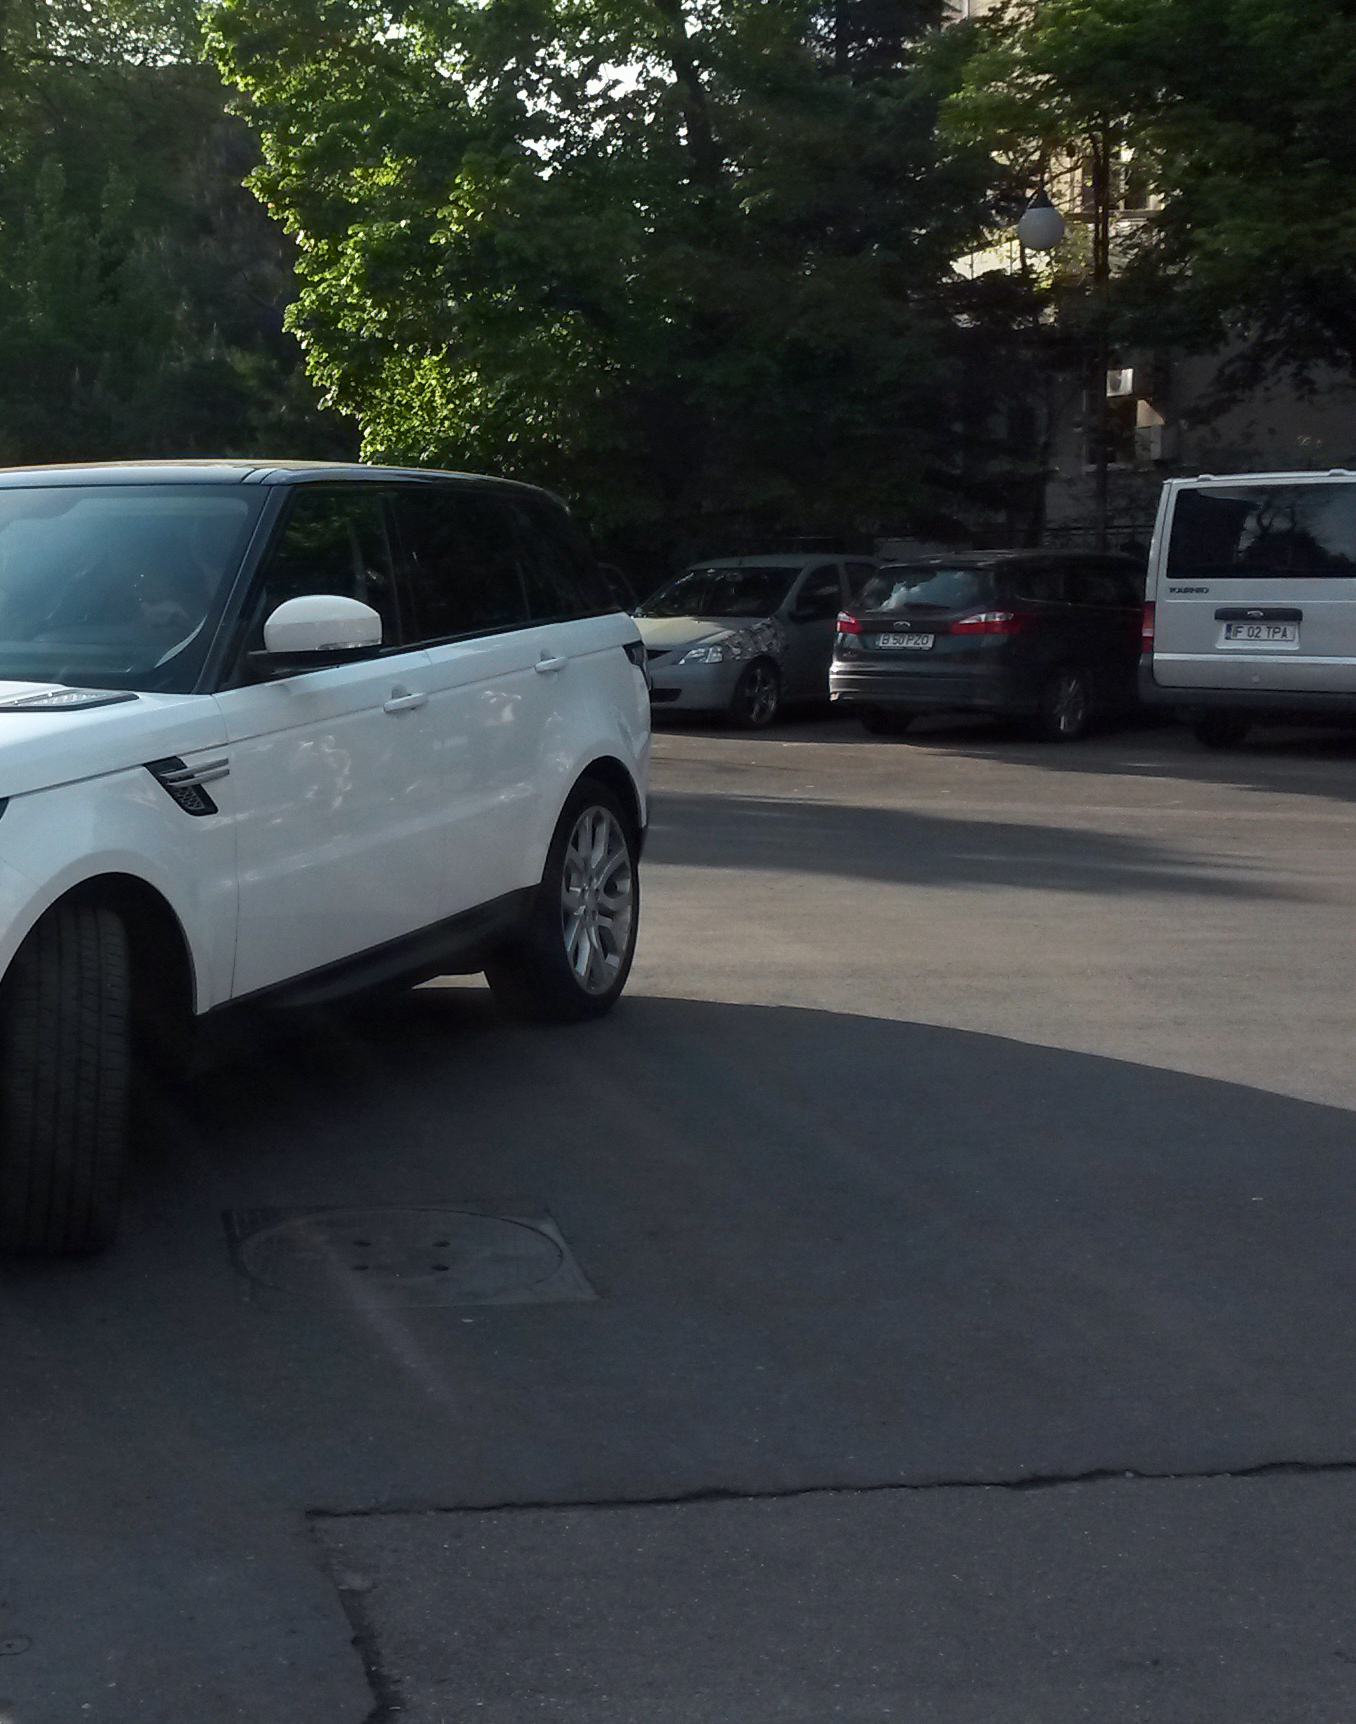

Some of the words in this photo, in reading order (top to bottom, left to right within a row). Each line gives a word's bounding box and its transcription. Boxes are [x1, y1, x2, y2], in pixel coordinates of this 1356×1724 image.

[1247, 625, 1261, 638] 02
[1266, 626, 1288, 639] TPA
[882, 633, 890, 645] B
